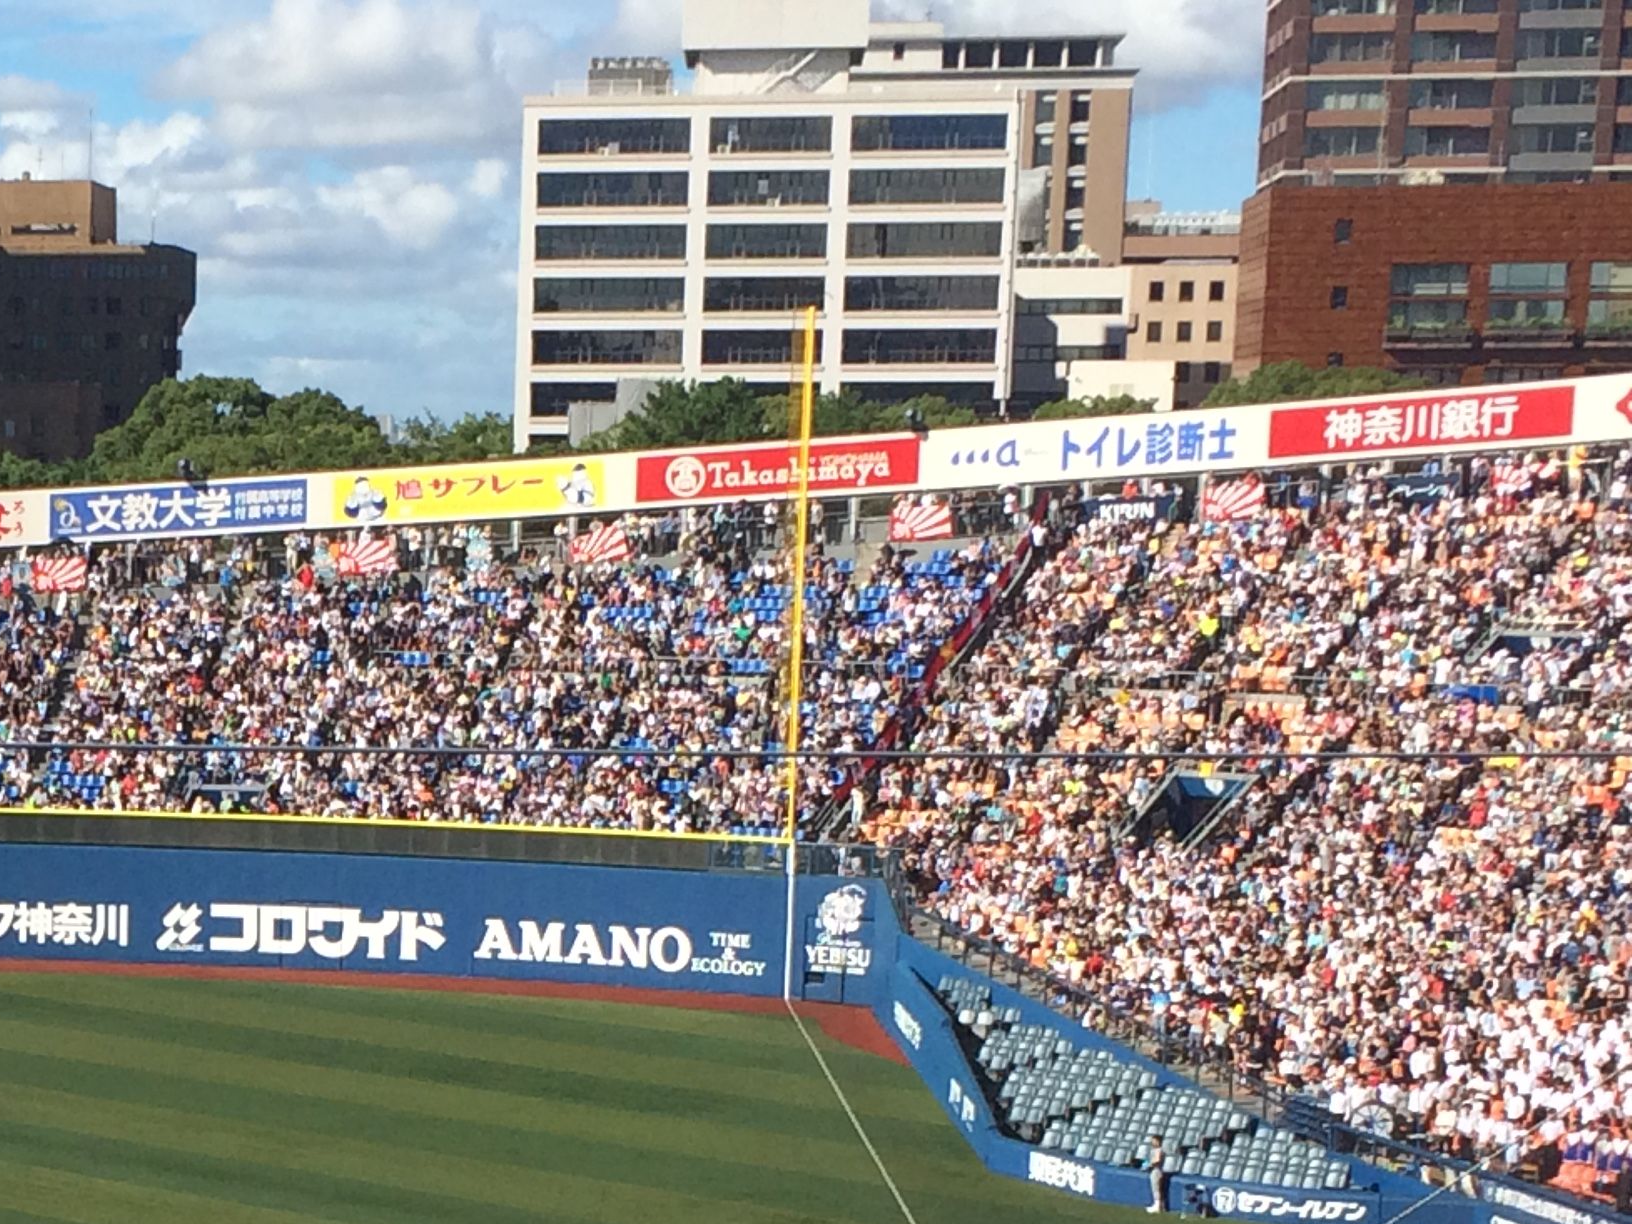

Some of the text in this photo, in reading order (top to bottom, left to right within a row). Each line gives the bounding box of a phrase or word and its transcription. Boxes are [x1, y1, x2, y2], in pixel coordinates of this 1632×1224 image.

[1324, 396, 1520, 448] 神奈川銀行
[1061, 418, 1236, 471] トイレ診断士
[708, 456, 890, 487] Takashimaya
[85, 488, 231, 533] 文教大学
[1099, 502, 1155, 522] KIRIN
[209, 902, 447, 961] コロワイド
[473, 917, 693, 973] AMANO
[709, 931, 752, 949] TIME
[690, 957, 767, 977] ECOLOGY
[805, 945, 871, 968] YEBISU
